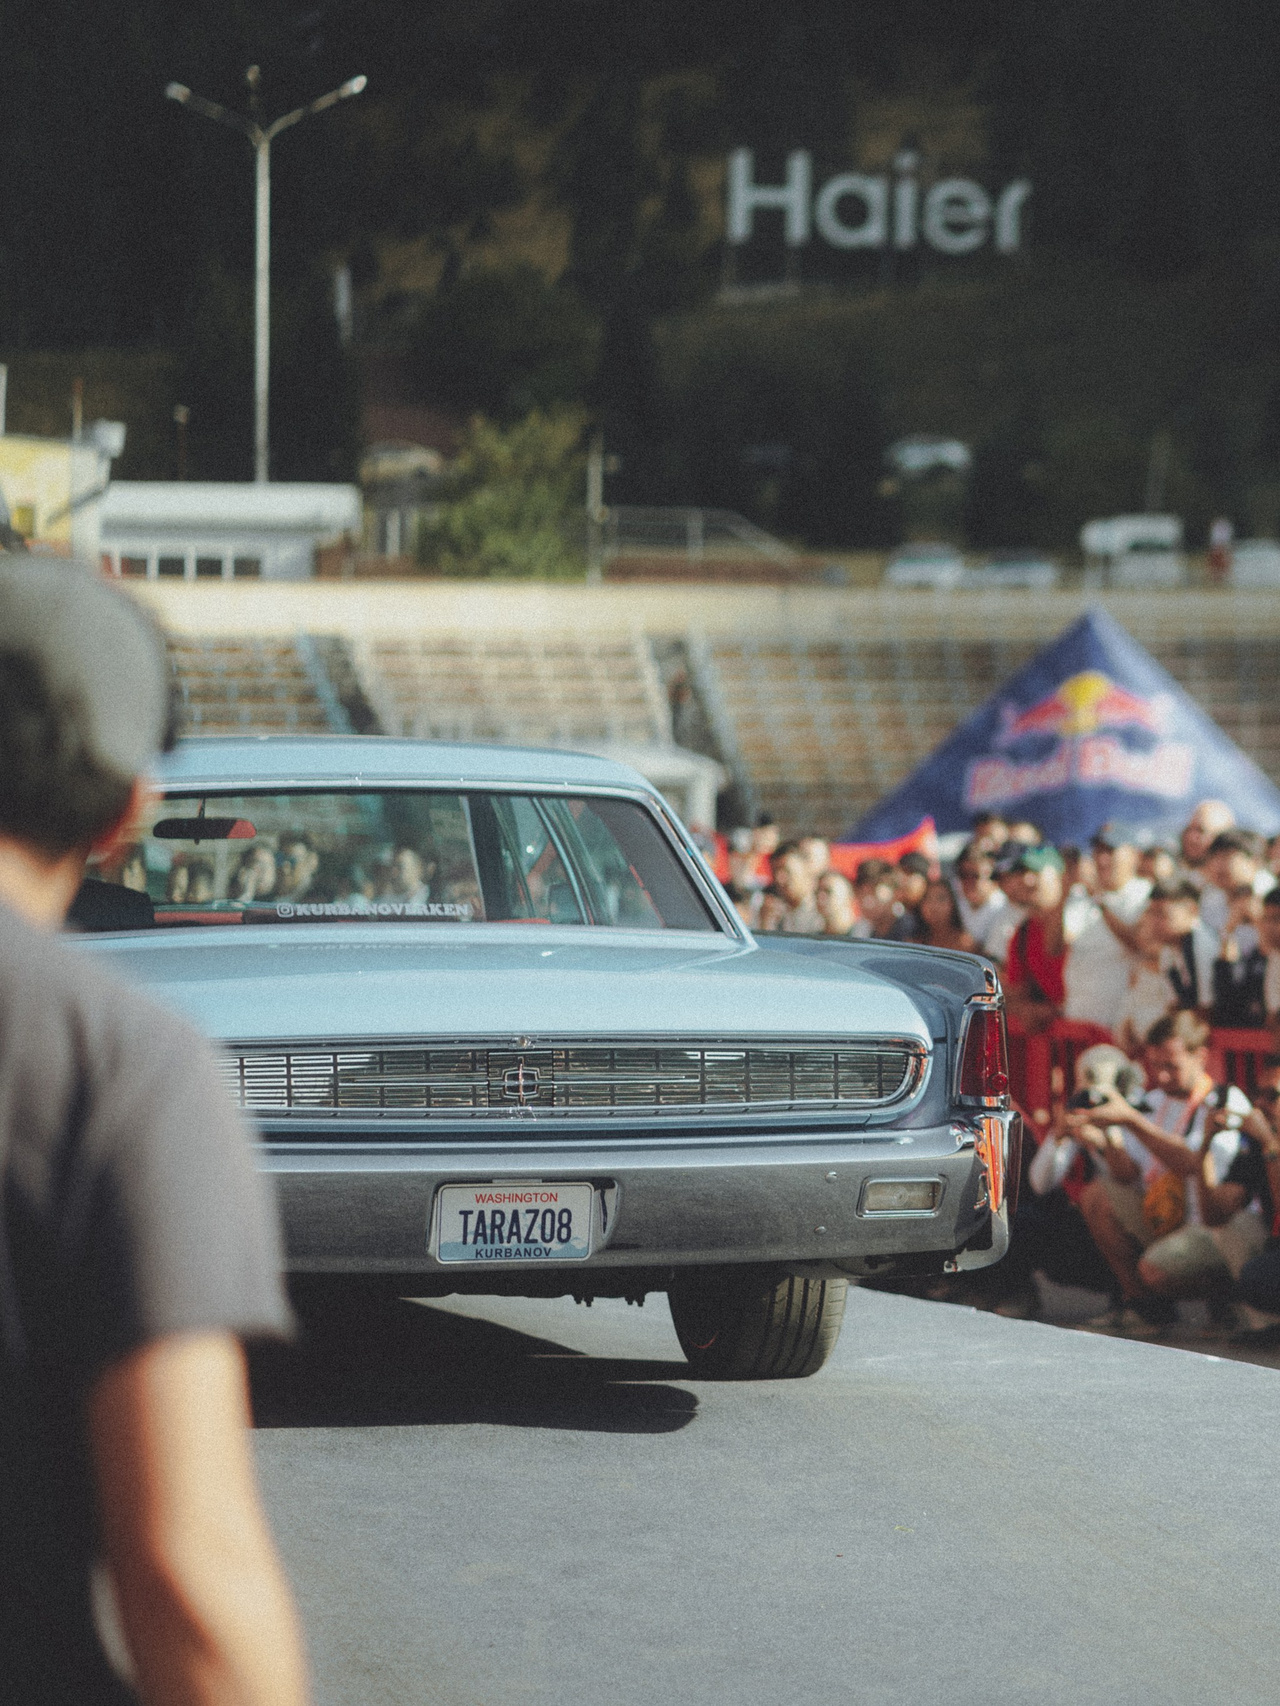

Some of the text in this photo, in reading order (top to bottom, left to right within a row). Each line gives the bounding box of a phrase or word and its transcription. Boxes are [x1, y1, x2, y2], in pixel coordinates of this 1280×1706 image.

[727, 147, 1034, 254] Haier
[296, 902, 470, 917] KURBANOVERKEN
[475, 1191, 559, 1204] WASHINGTON
[458, 1207, 573, 1246] TARAZ08
[475, 1246, 553, 1259] KURBANOV
